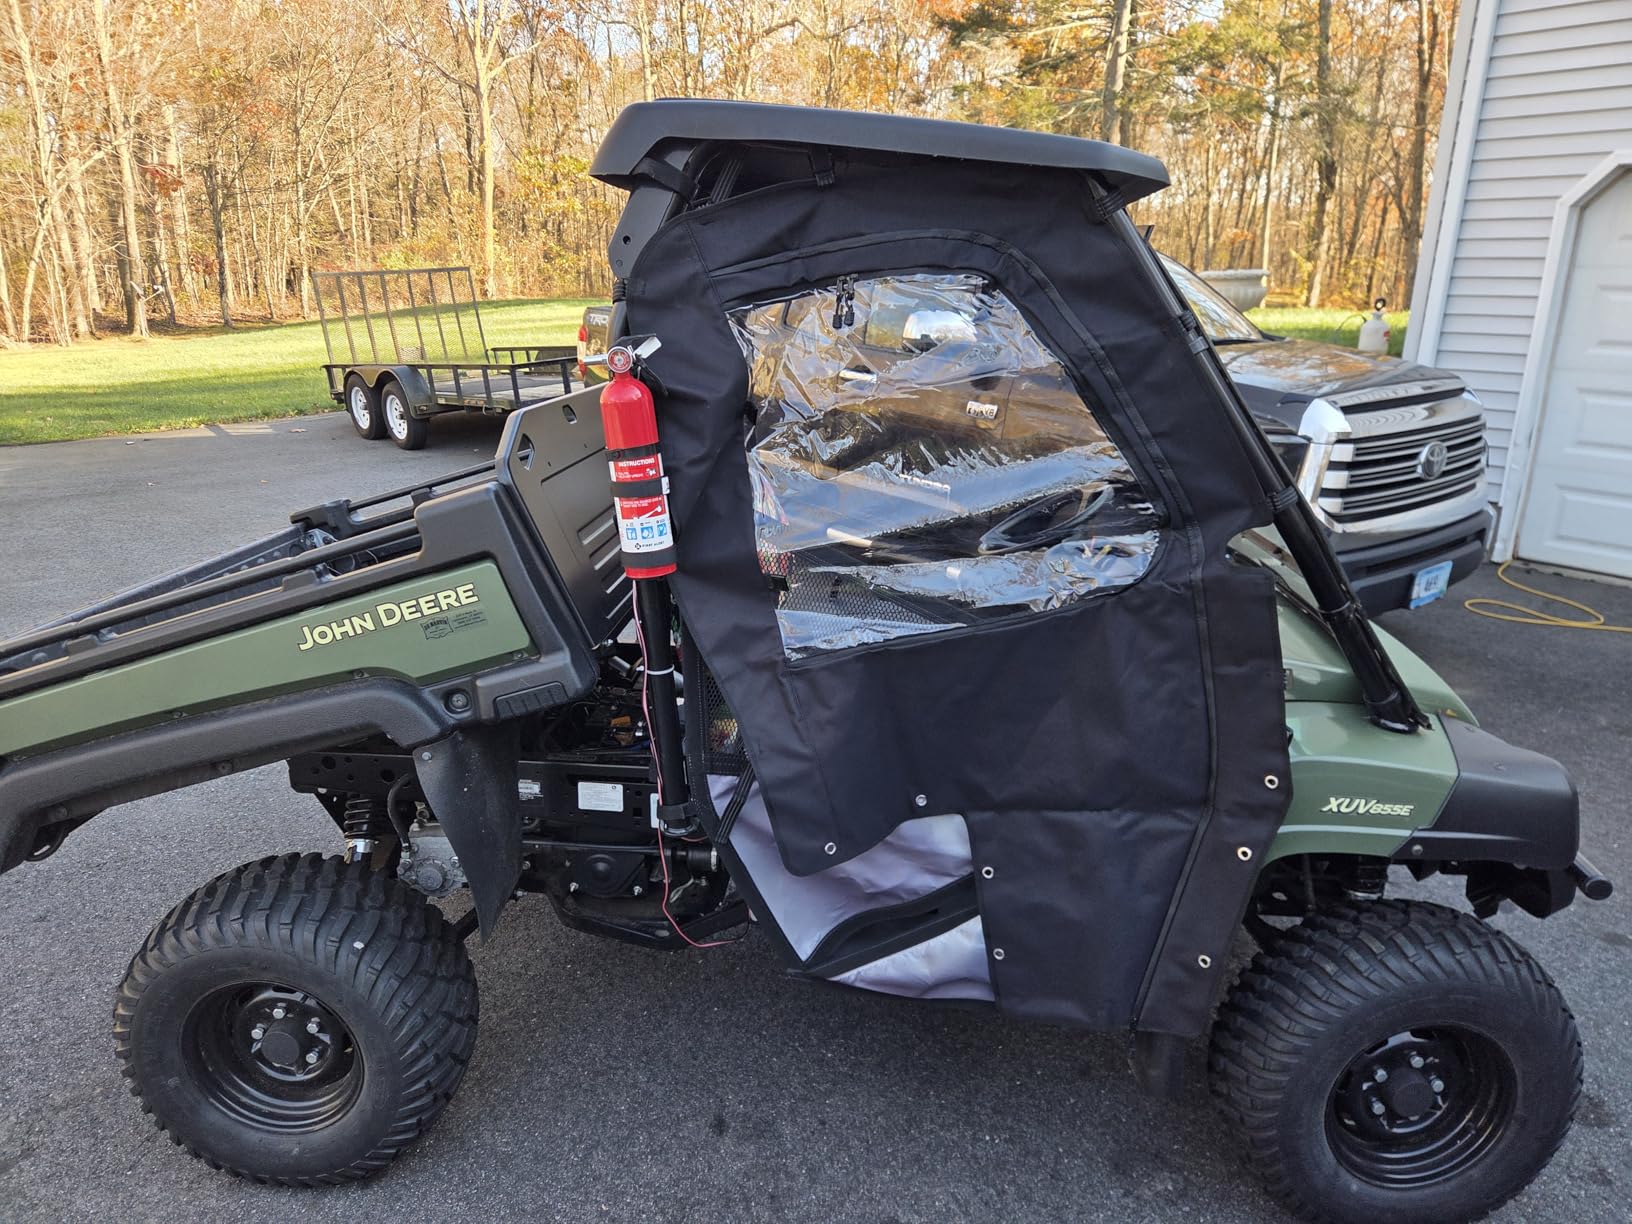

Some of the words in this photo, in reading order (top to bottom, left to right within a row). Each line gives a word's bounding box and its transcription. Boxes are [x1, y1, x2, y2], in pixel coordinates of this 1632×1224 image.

[298, 612, 376, 650] JOHN
[375, 583, 480, 627] DEERE
[1320, 797, 1414, 816] XUV855E
